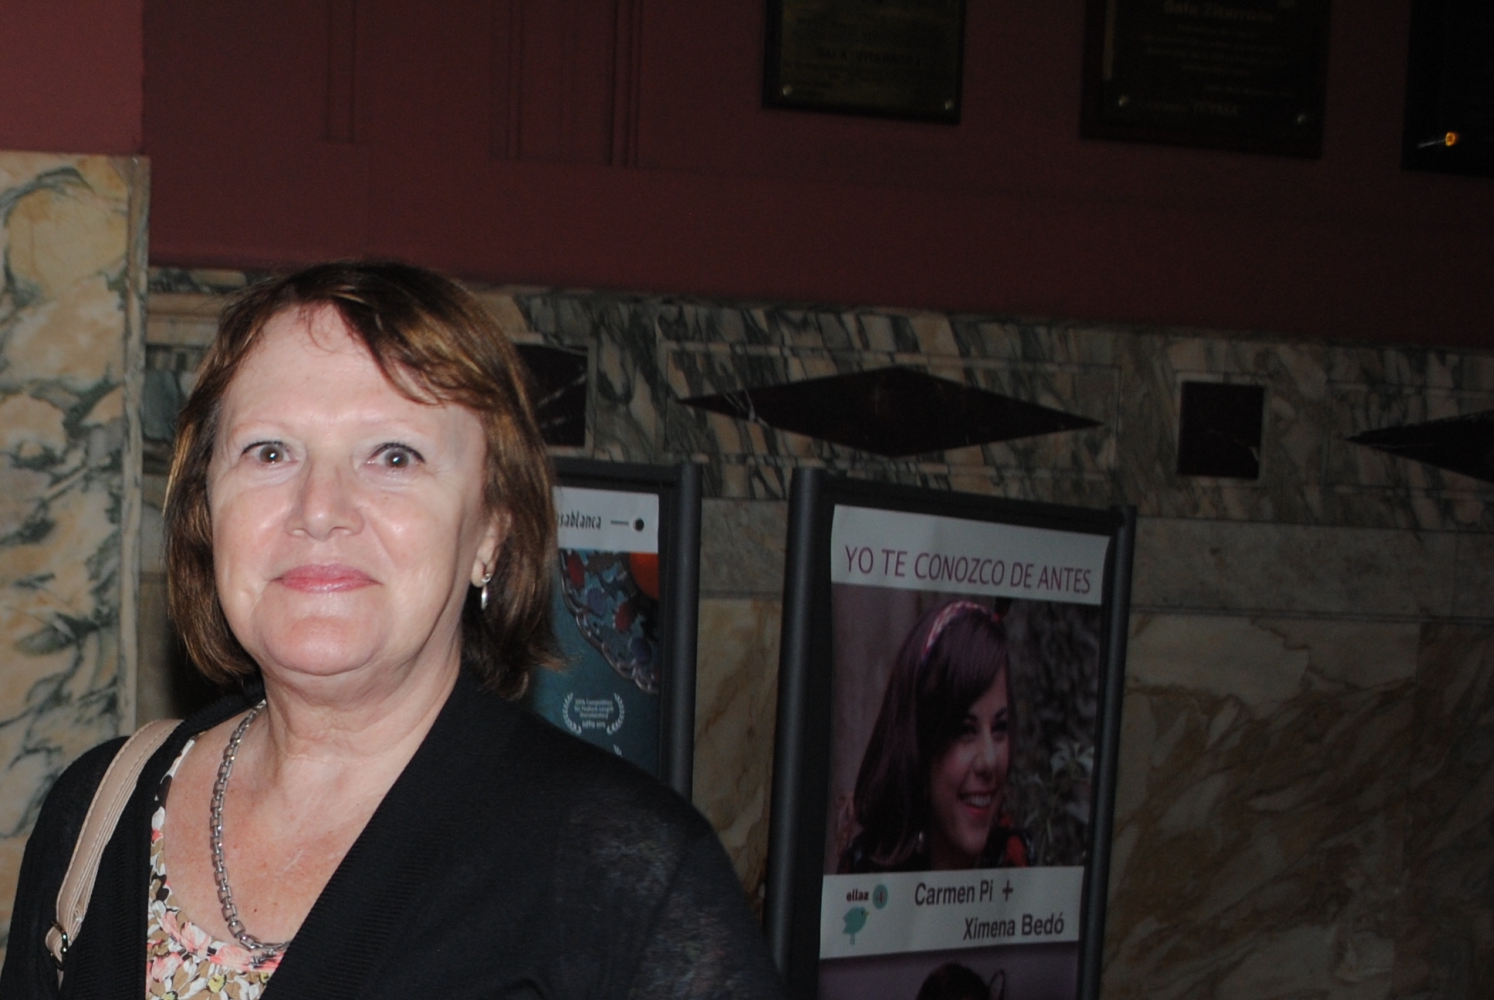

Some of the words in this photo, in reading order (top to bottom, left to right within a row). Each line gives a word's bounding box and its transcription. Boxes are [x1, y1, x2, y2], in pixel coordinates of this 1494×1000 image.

[557, 510, 601, 529] sablanca
[844, 545, 874, 575] YO
[881, 548, 907, 577] TE
[914, 552, 1005, 587] CONOZCO
[1010, 561, 1034, 589] DE
[1037, 565, 1091, 594] ANTES
[914, 882, 975, 906] Carmen
[979, 880, 993, 903] Pi
[962, 917, 1015, 940] Ximena
[1021, 912, 1064, 935] Bedó
